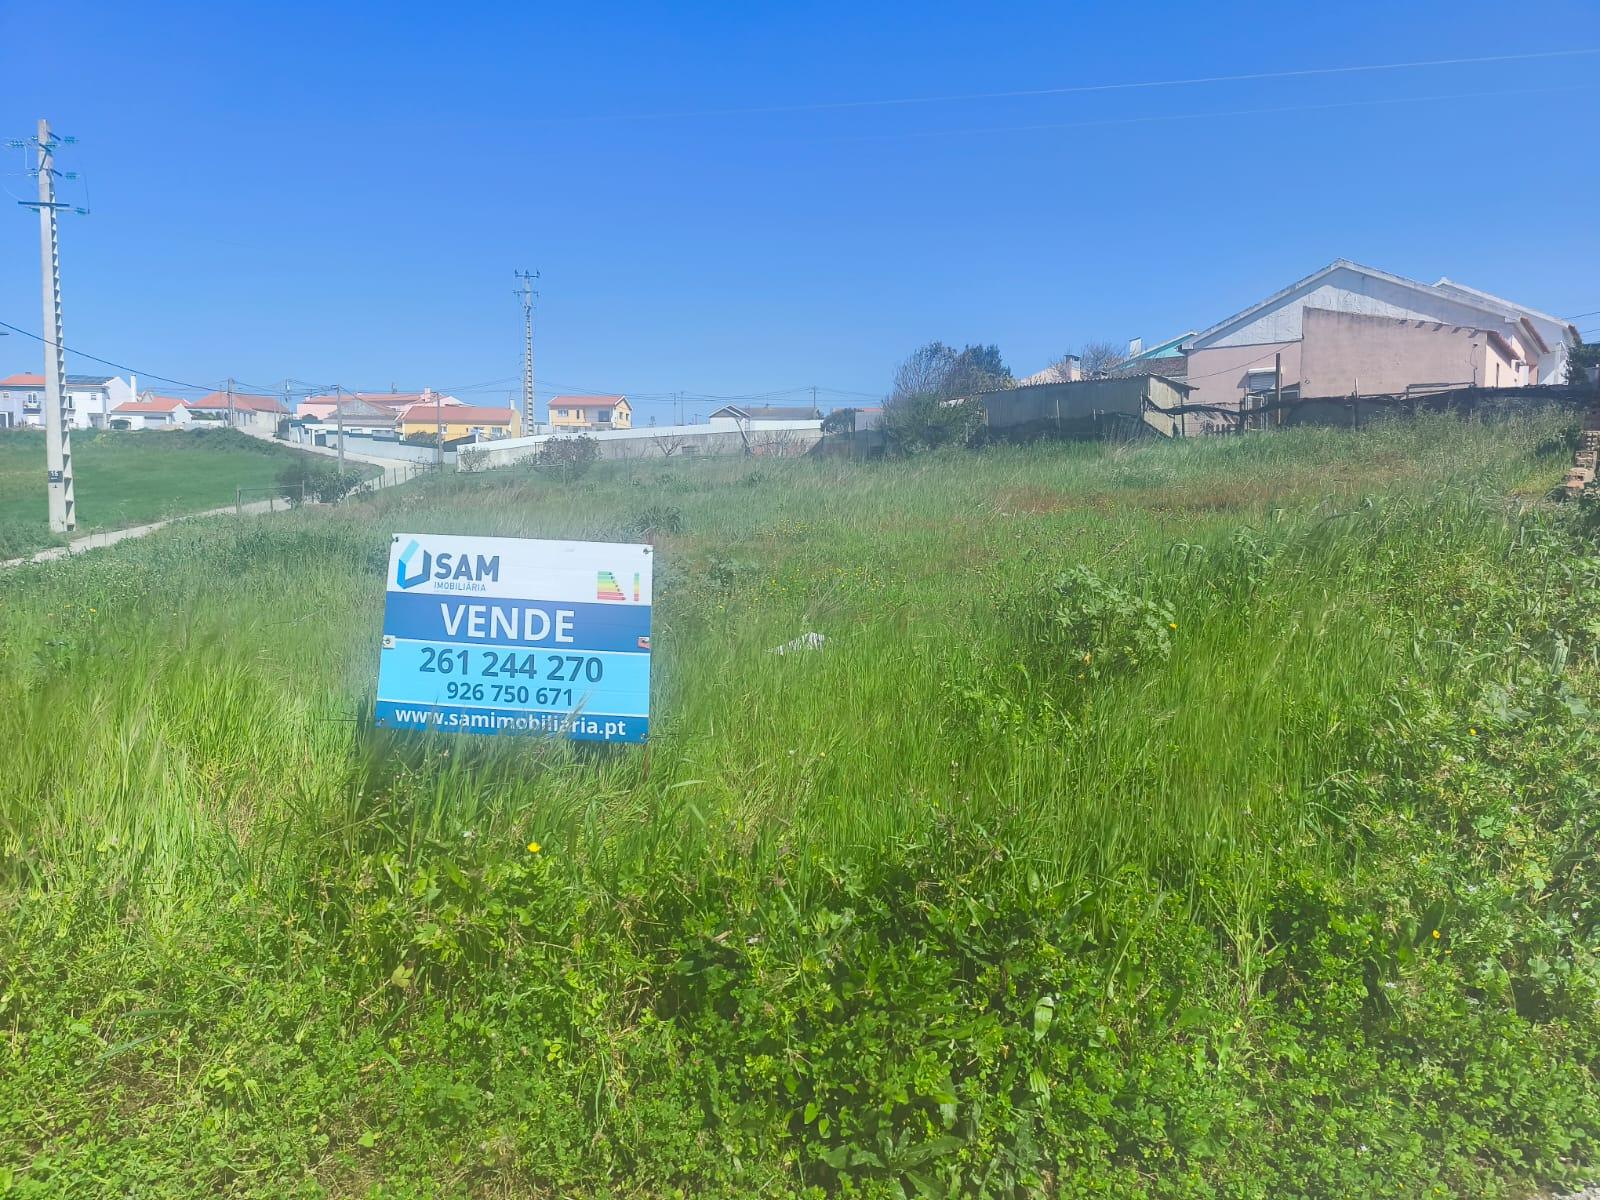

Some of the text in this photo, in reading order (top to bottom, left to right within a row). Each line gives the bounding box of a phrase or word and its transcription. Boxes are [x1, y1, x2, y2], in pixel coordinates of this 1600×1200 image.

[434, 552, 500, 582] SAM
[434, 581, 487, 592] IMOBILIÁRIA
[440, 603, 575, 643] VENDE
[419, 647, 603, 682] 261 244 270
[446, 681, 573, 706] 926 750 671
